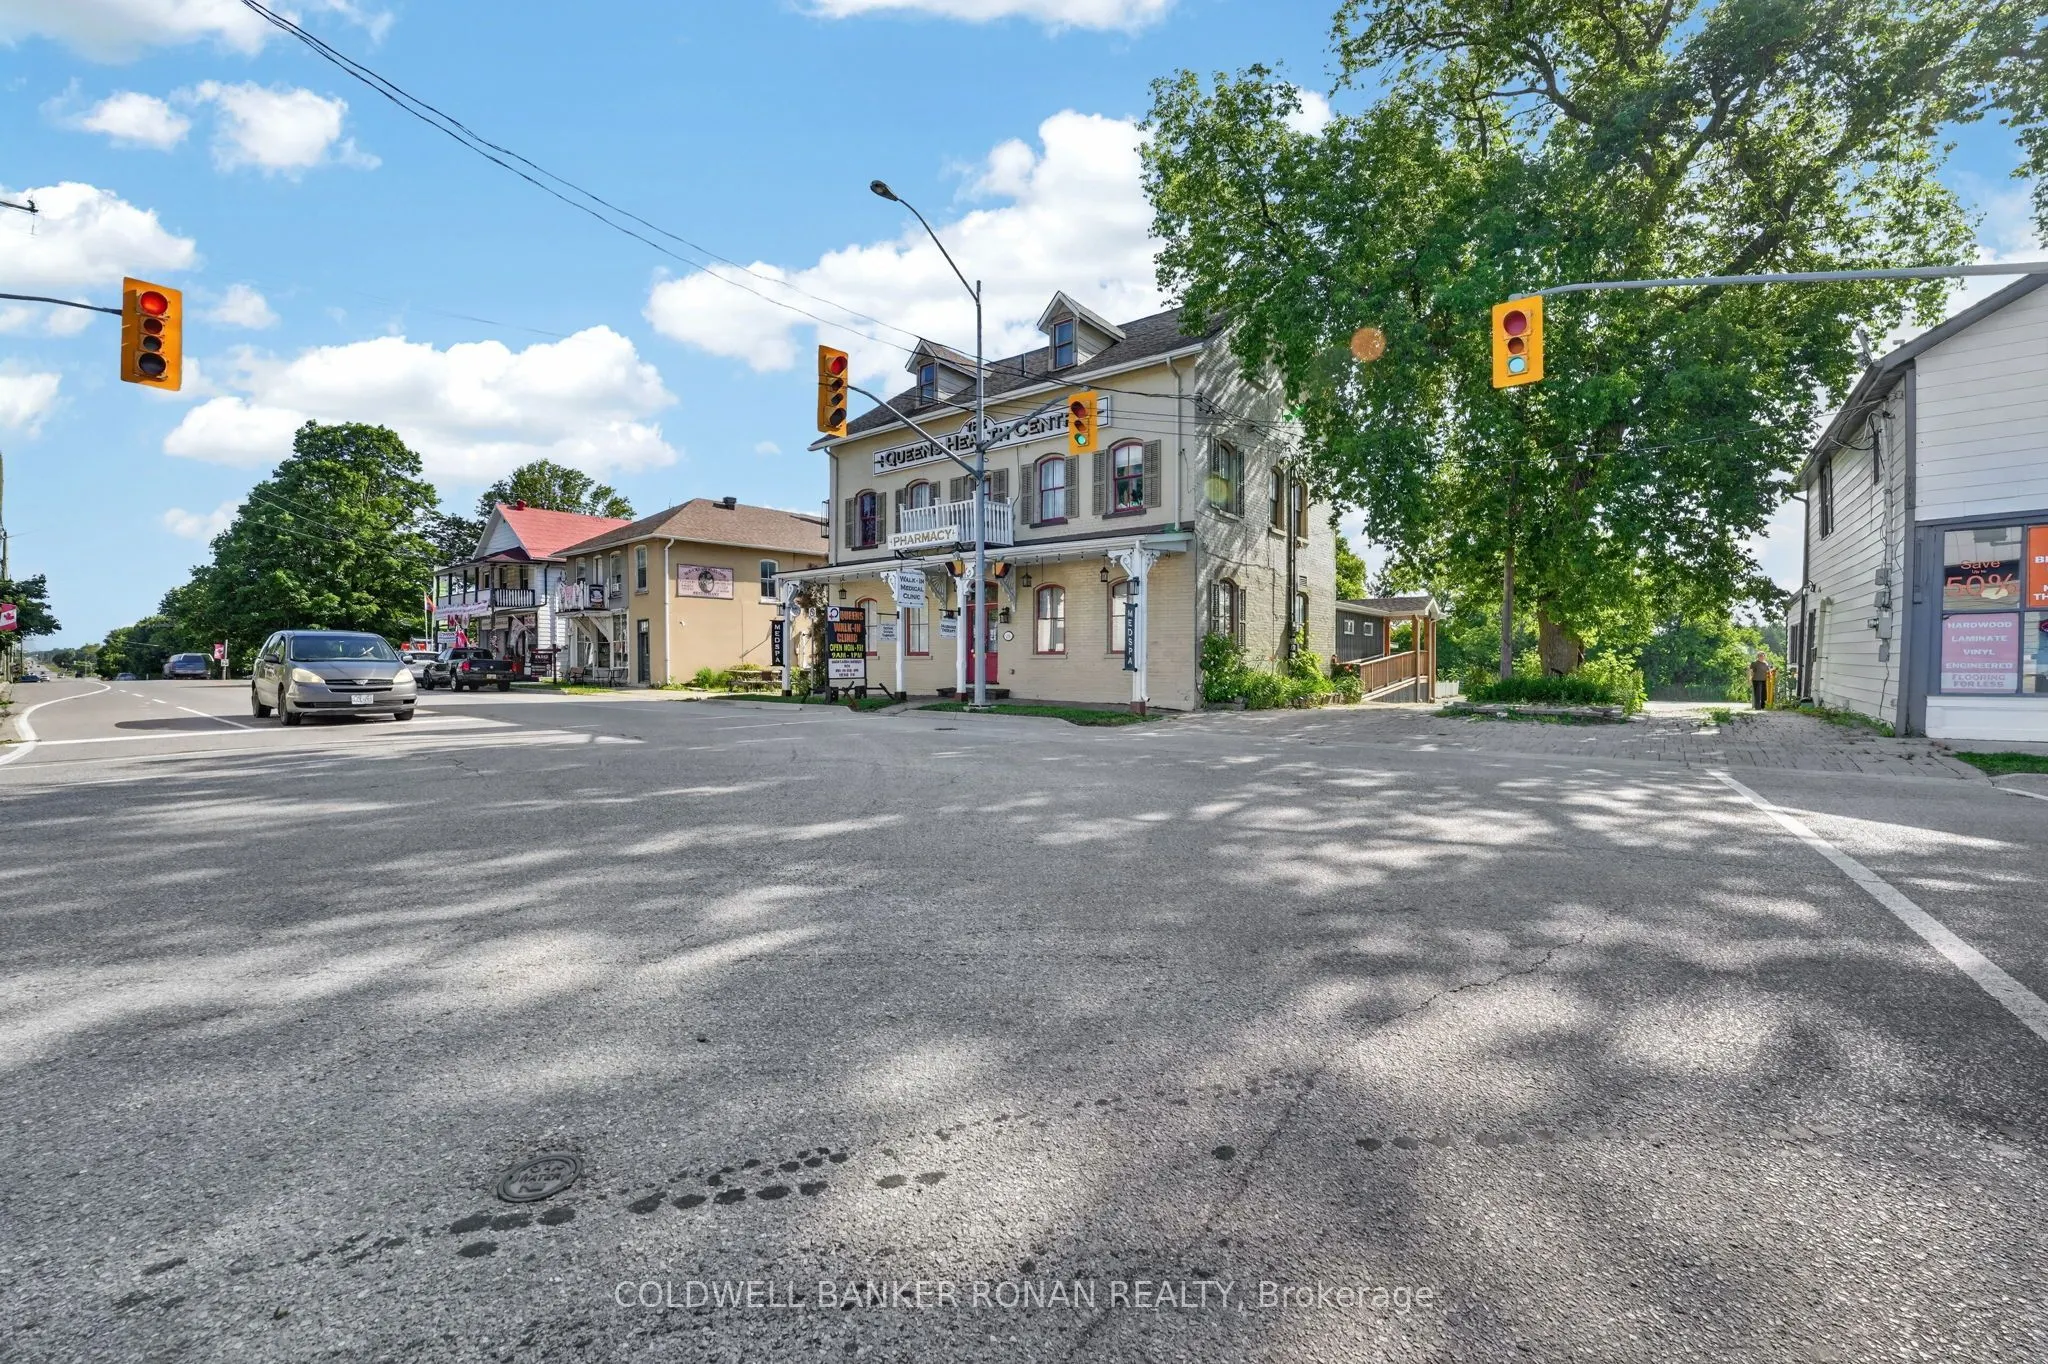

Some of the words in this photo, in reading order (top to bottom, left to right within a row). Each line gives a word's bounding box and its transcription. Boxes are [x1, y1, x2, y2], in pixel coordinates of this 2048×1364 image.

[885, 442, 943, 466] QUEENS
[946, 426, 1011, 451] HEATH
[893, 528, 953, 546] PHARMACY
[1960, 559, 2001, 570] Save
[900, 576, 925, 584] WALK-IN
[1946, 573, 2017, 597] 50%
[840, 611, 864, 620] QUEENS
[833, 623, 862, 632] WALK-IN
[1947, 621, 2013, 629] HARDWOOD
[836, 633, 858, 642] CLINIC
[1951, 634, 2008, 642] LAMINATE
[829, 643, 843, 651] OPEN
